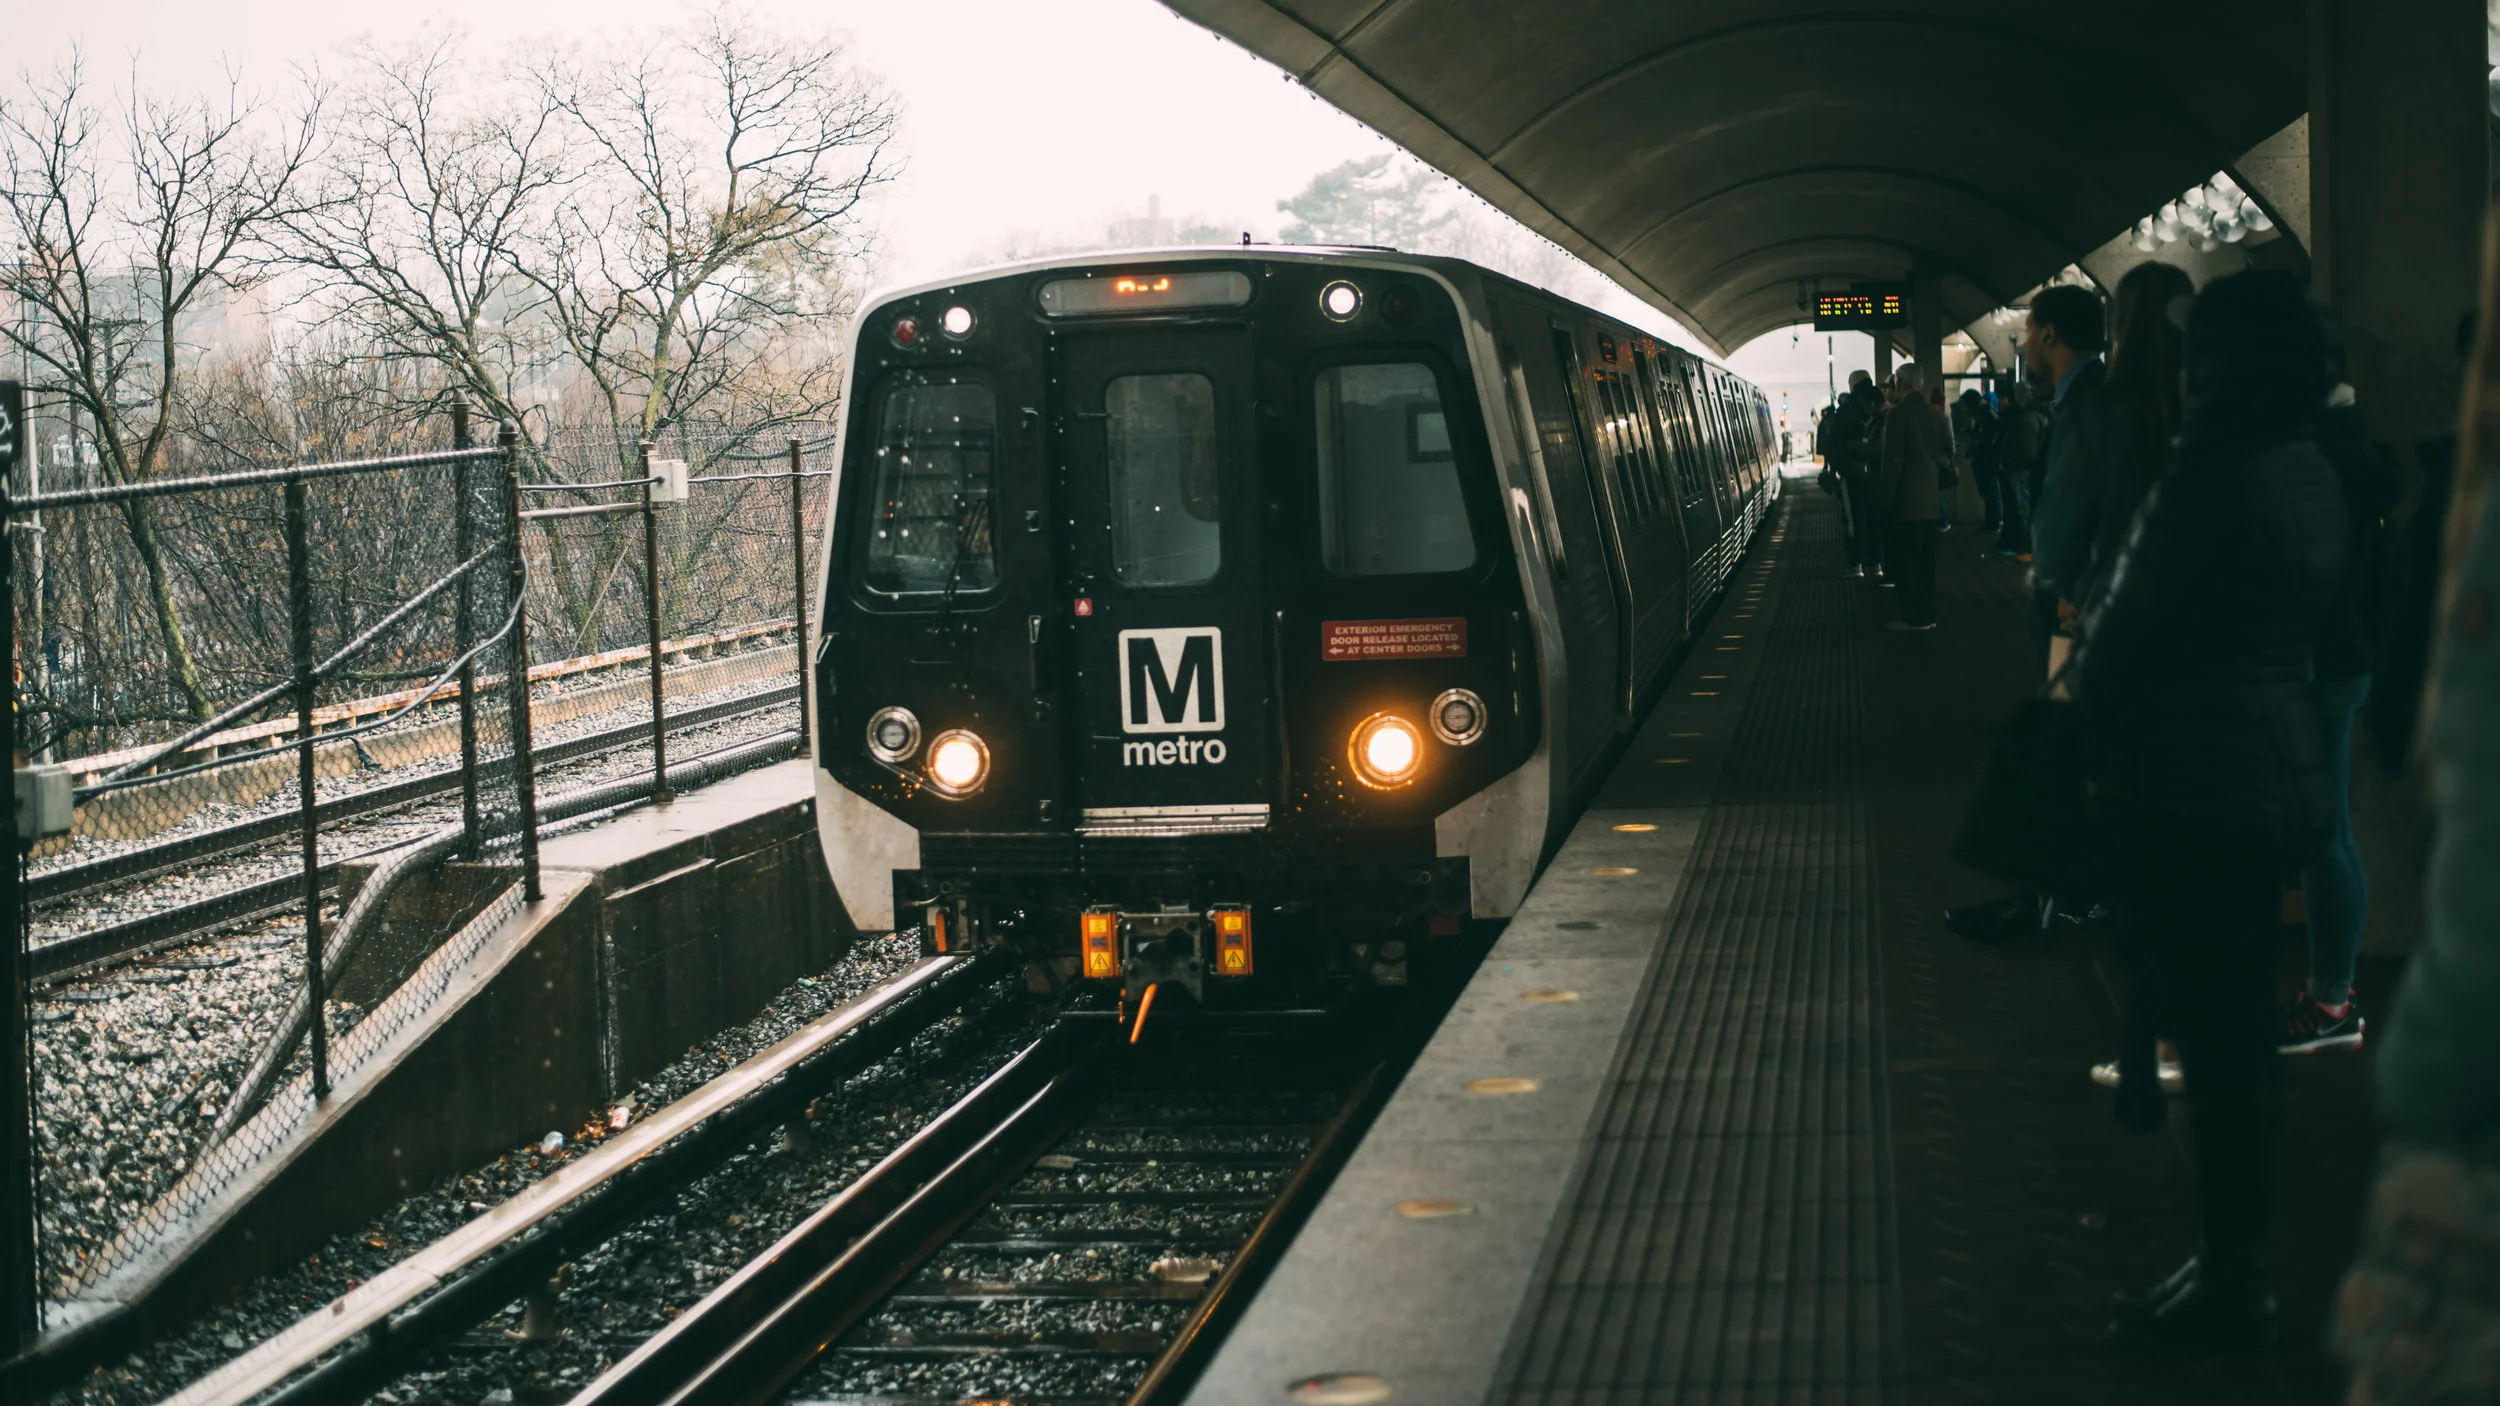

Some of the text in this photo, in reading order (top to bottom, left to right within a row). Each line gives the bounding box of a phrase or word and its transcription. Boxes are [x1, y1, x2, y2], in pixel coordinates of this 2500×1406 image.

[1335, 624, 1453, 635] EXTERIOR EMERGENCY
[1330, 633, 1458, 645] DOOR RELEASE LOCATED
[1347, 643, 1443, 655] AT CENTER DOORS
[1128, 635, 1216, 725] M
[1123, 735, 1227, 766] metro
